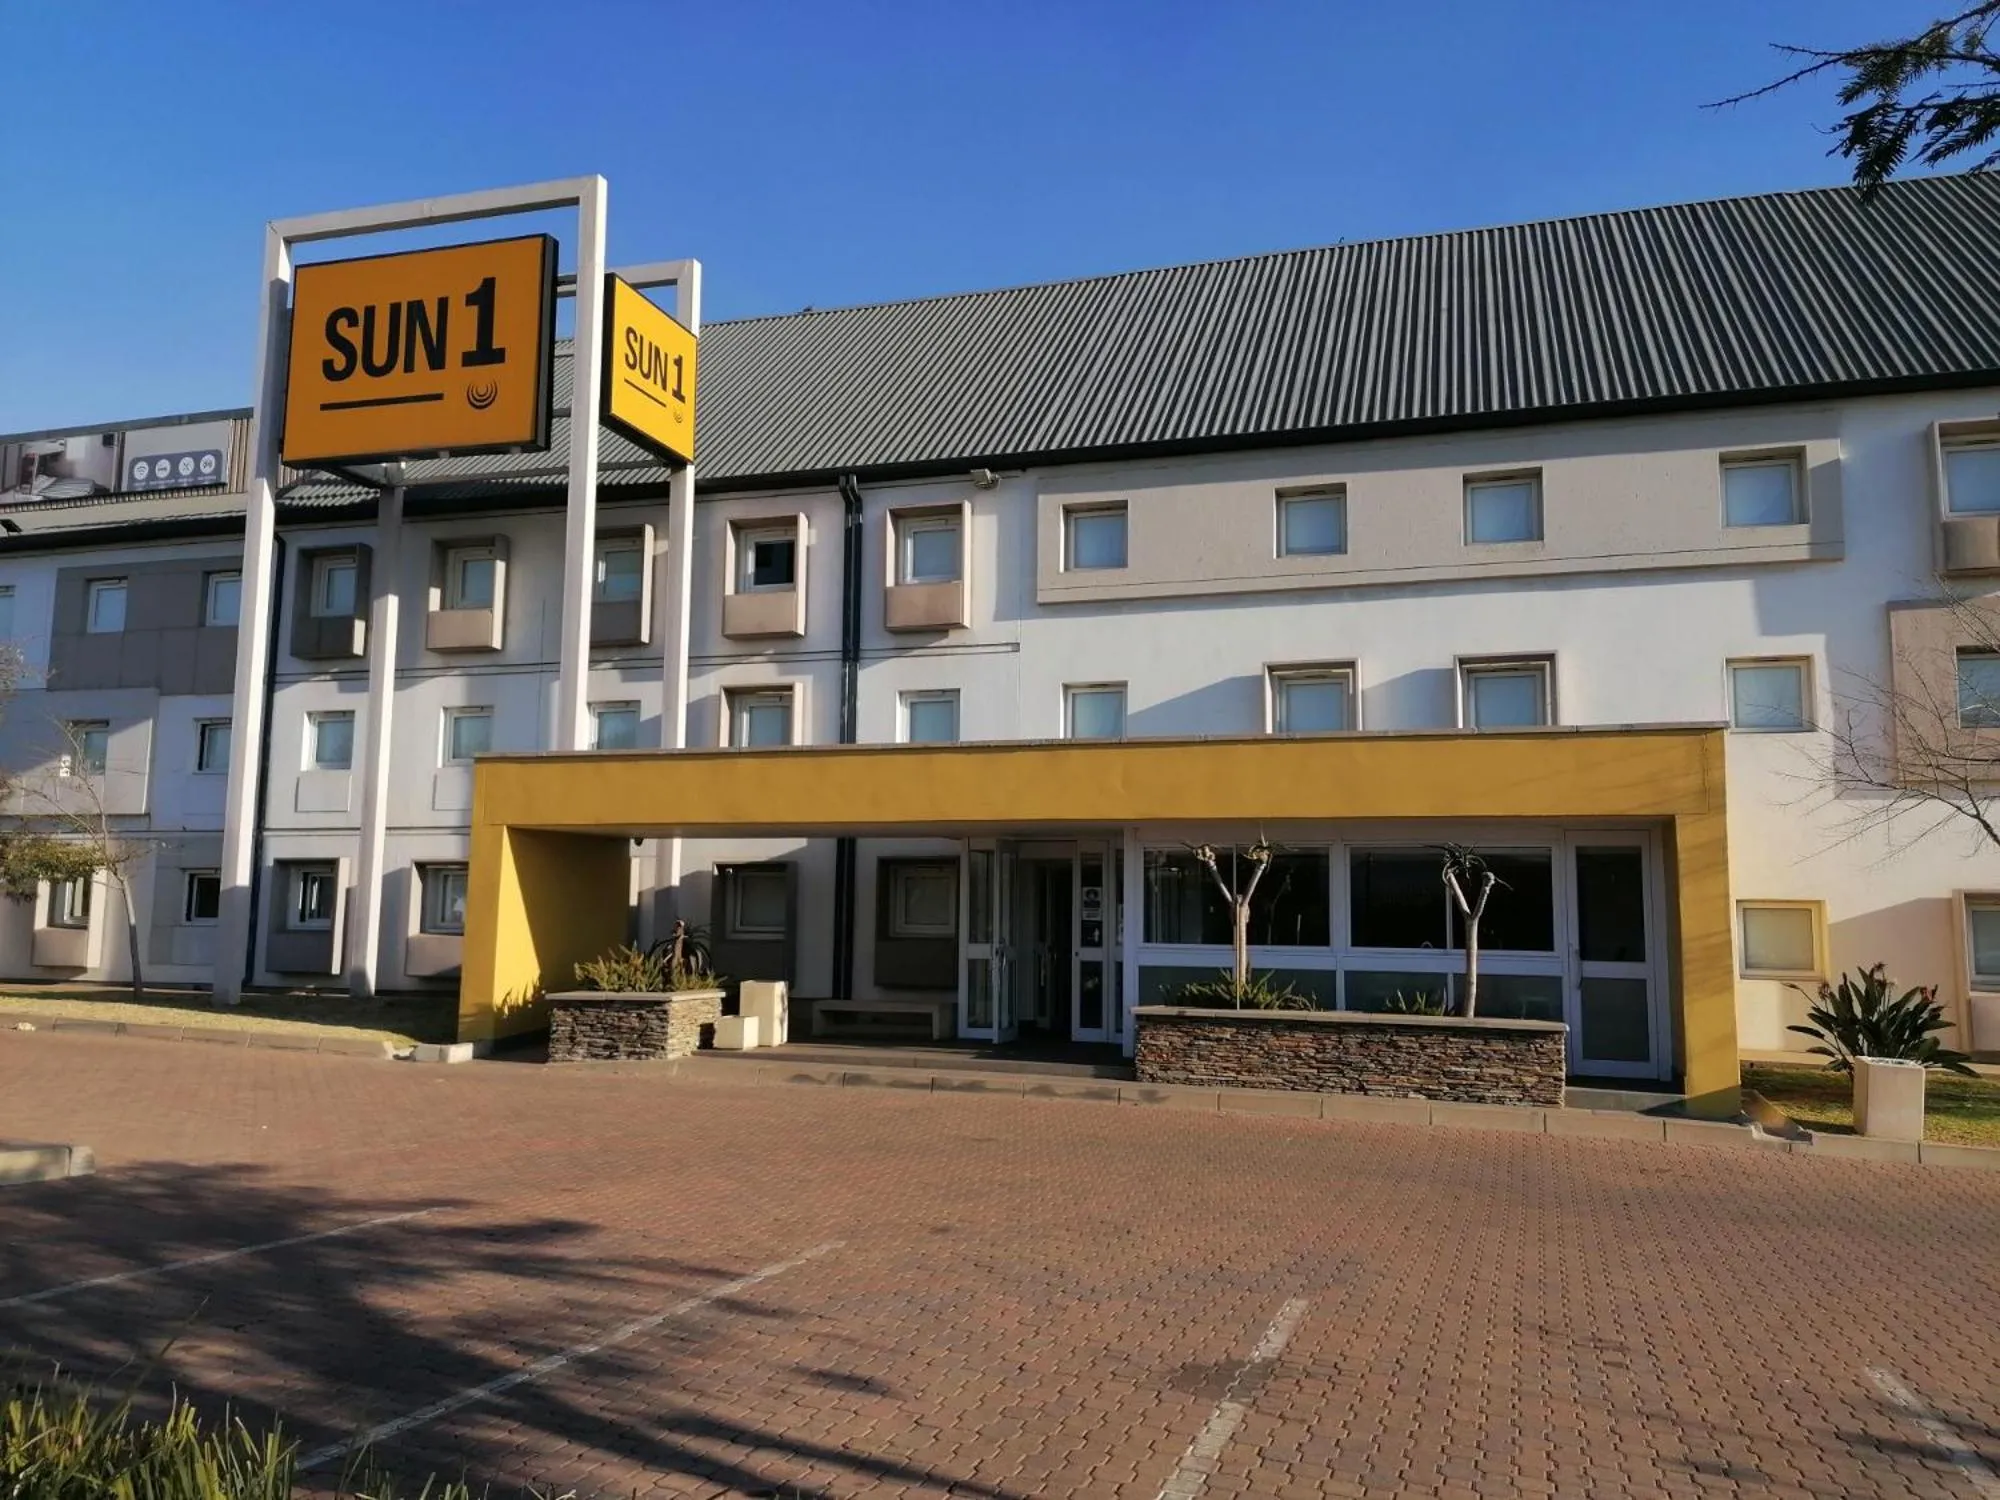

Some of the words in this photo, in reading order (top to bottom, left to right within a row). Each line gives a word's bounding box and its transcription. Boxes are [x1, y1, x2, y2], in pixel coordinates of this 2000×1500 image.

[322, 296, 449, 382] SUN
[461, 276, 506, 367] 1
[624, 326, 668, 391] SUN
[671, 354, 686, 404] 1
